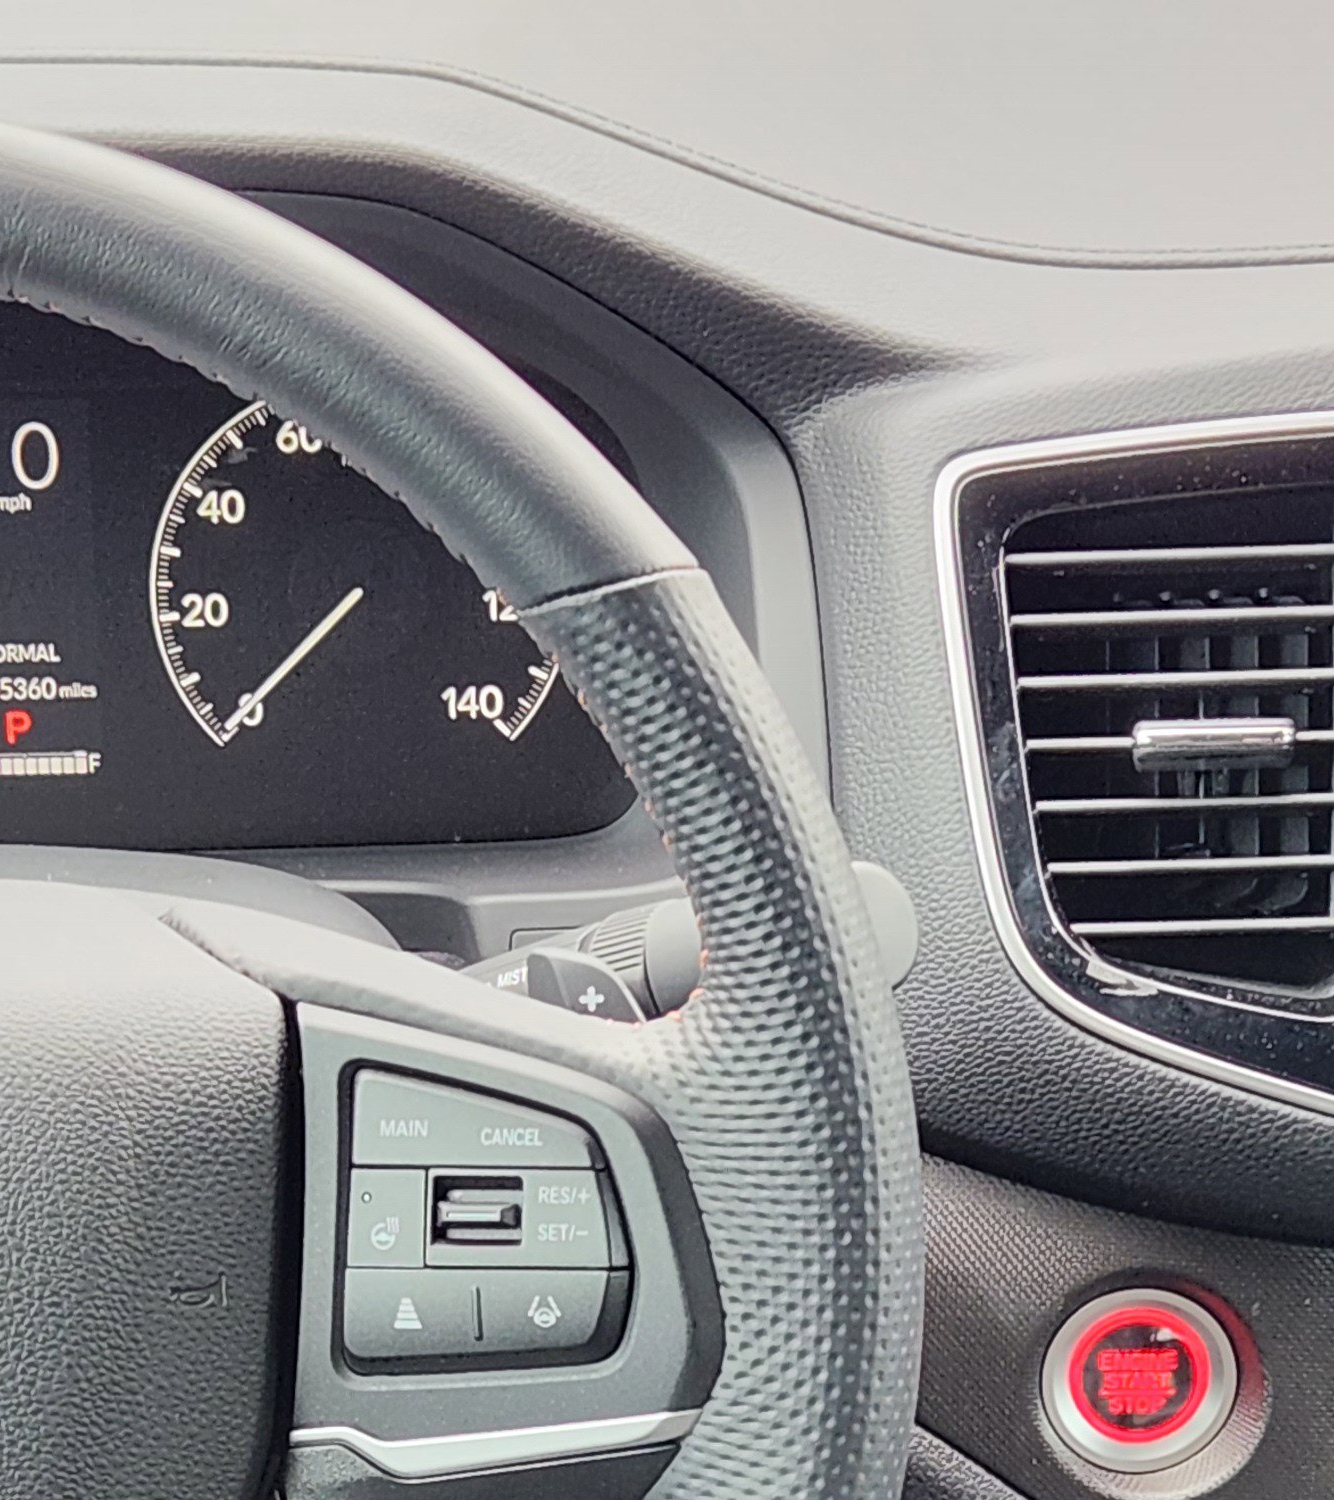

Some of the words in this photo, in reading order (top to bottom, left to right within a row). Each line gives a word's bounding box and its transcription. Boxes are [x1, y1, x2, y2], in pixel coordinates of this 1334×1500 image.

[11, 421, 59, 491] 0
[196, 489, 246, 526] 40
[180, 593, 230, 628] 20
[482, 589, 520, 622] 12
[58, 680, 98, 701] miles
[440, 684, 505, 721] 140
[4, 709, 33, 744] P
[88, 753, 102, 775] F
[497, 966, 529, 989] MIST
[380, 1118, 430, 1139] MAIN
[480, 1127, 544, 1147] CANCEL
[1103, 1371, 1174, 1390] START
